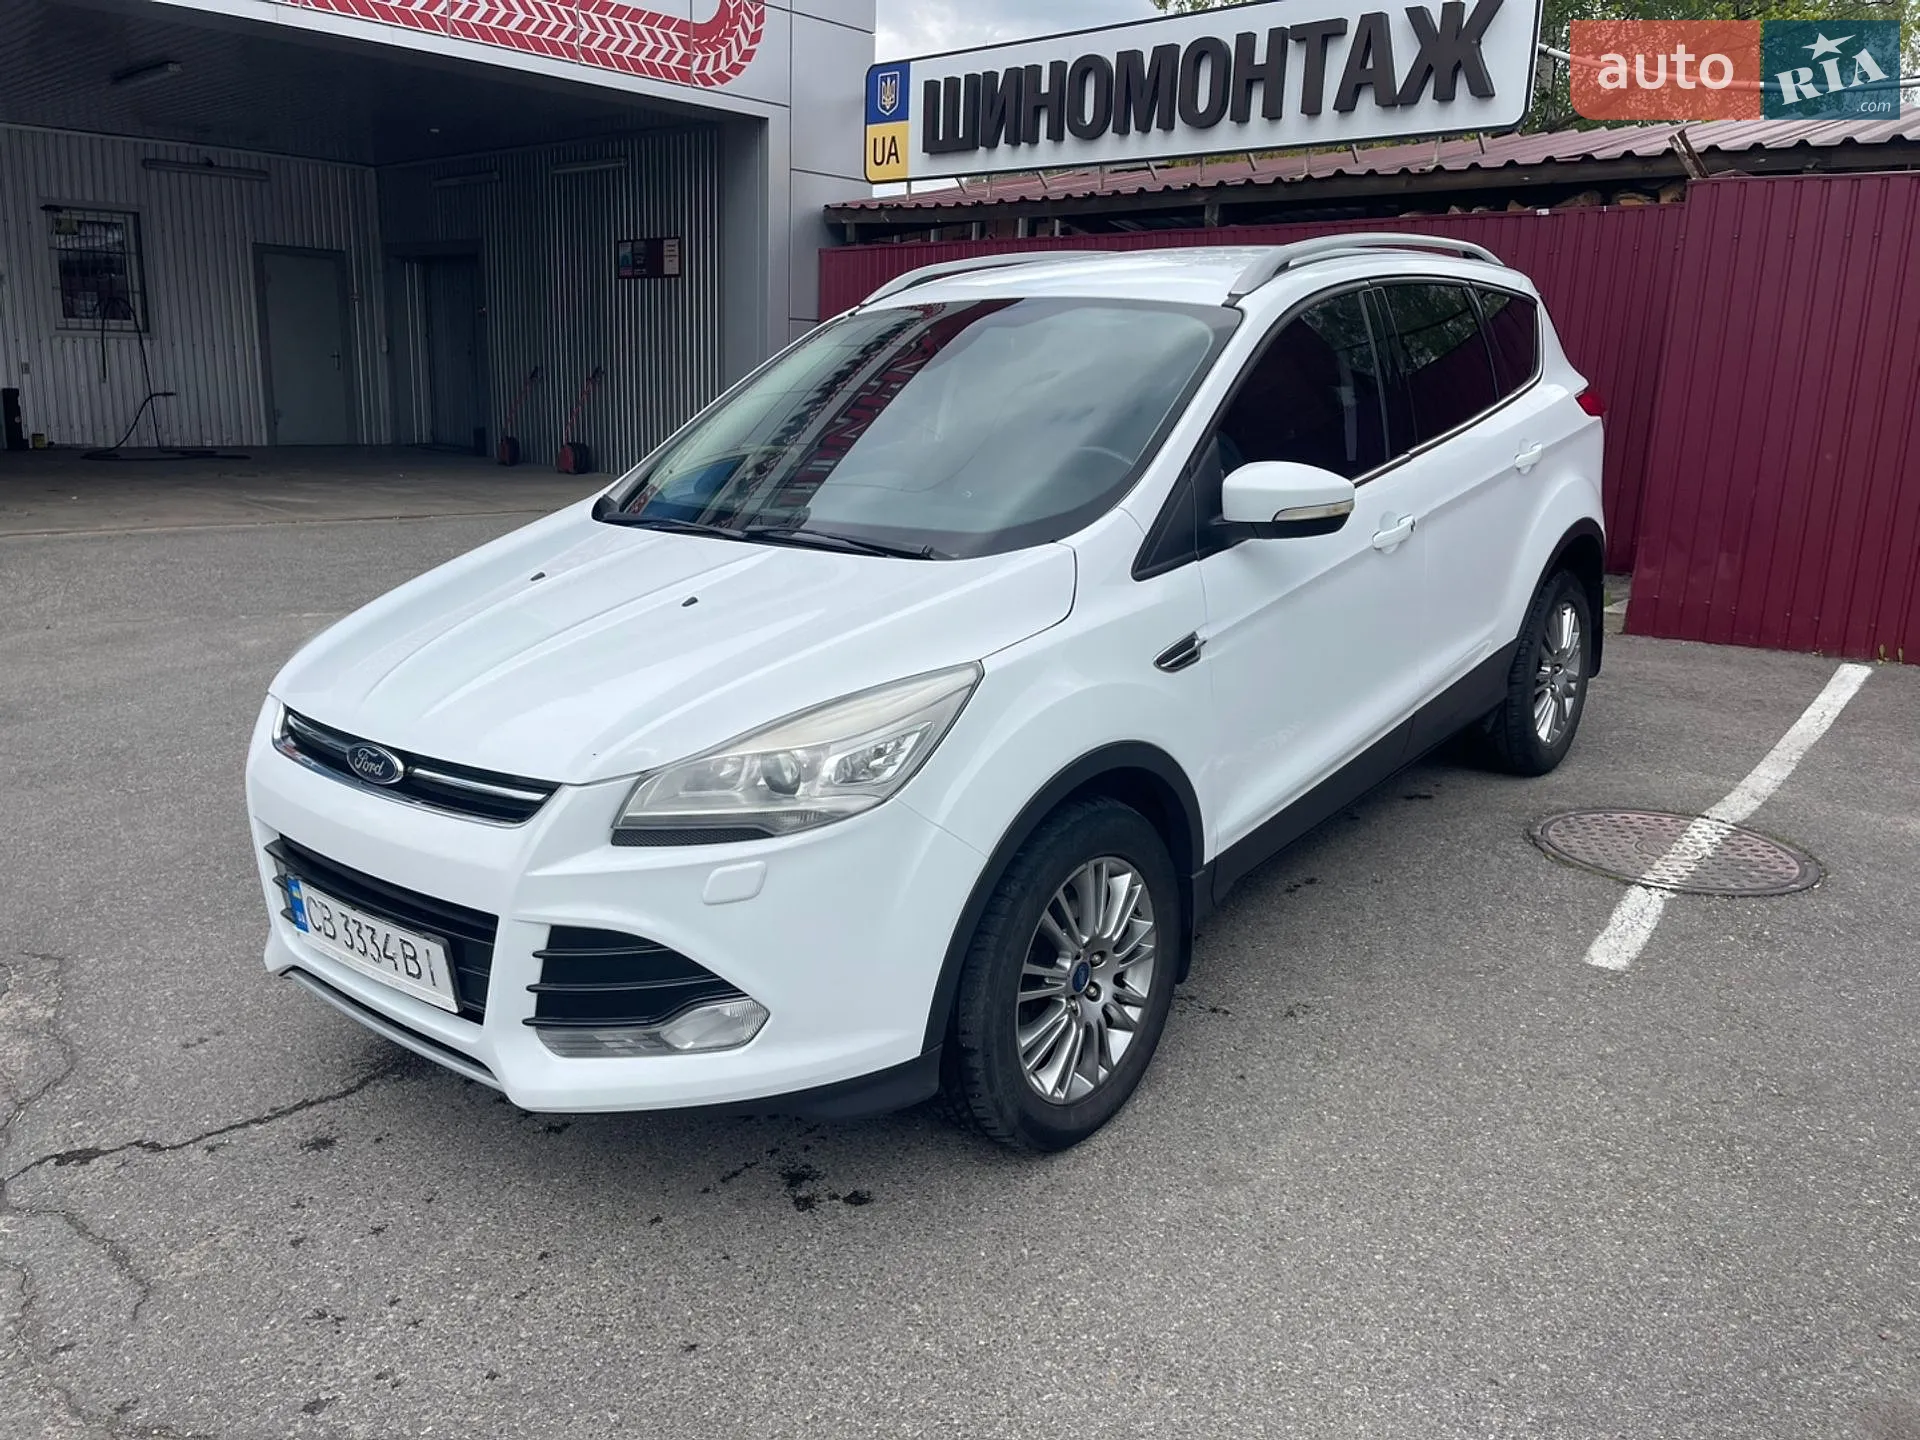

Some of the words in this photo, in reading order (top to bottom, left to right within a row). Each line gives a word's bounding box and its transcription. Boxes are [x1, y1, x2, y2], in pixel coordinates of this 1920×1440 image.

[922, 0, 1504, 155] ШИНОМОНТАЖ
[873, 135, 900, 166] UA
[354, 747, 385, 777] Ford
